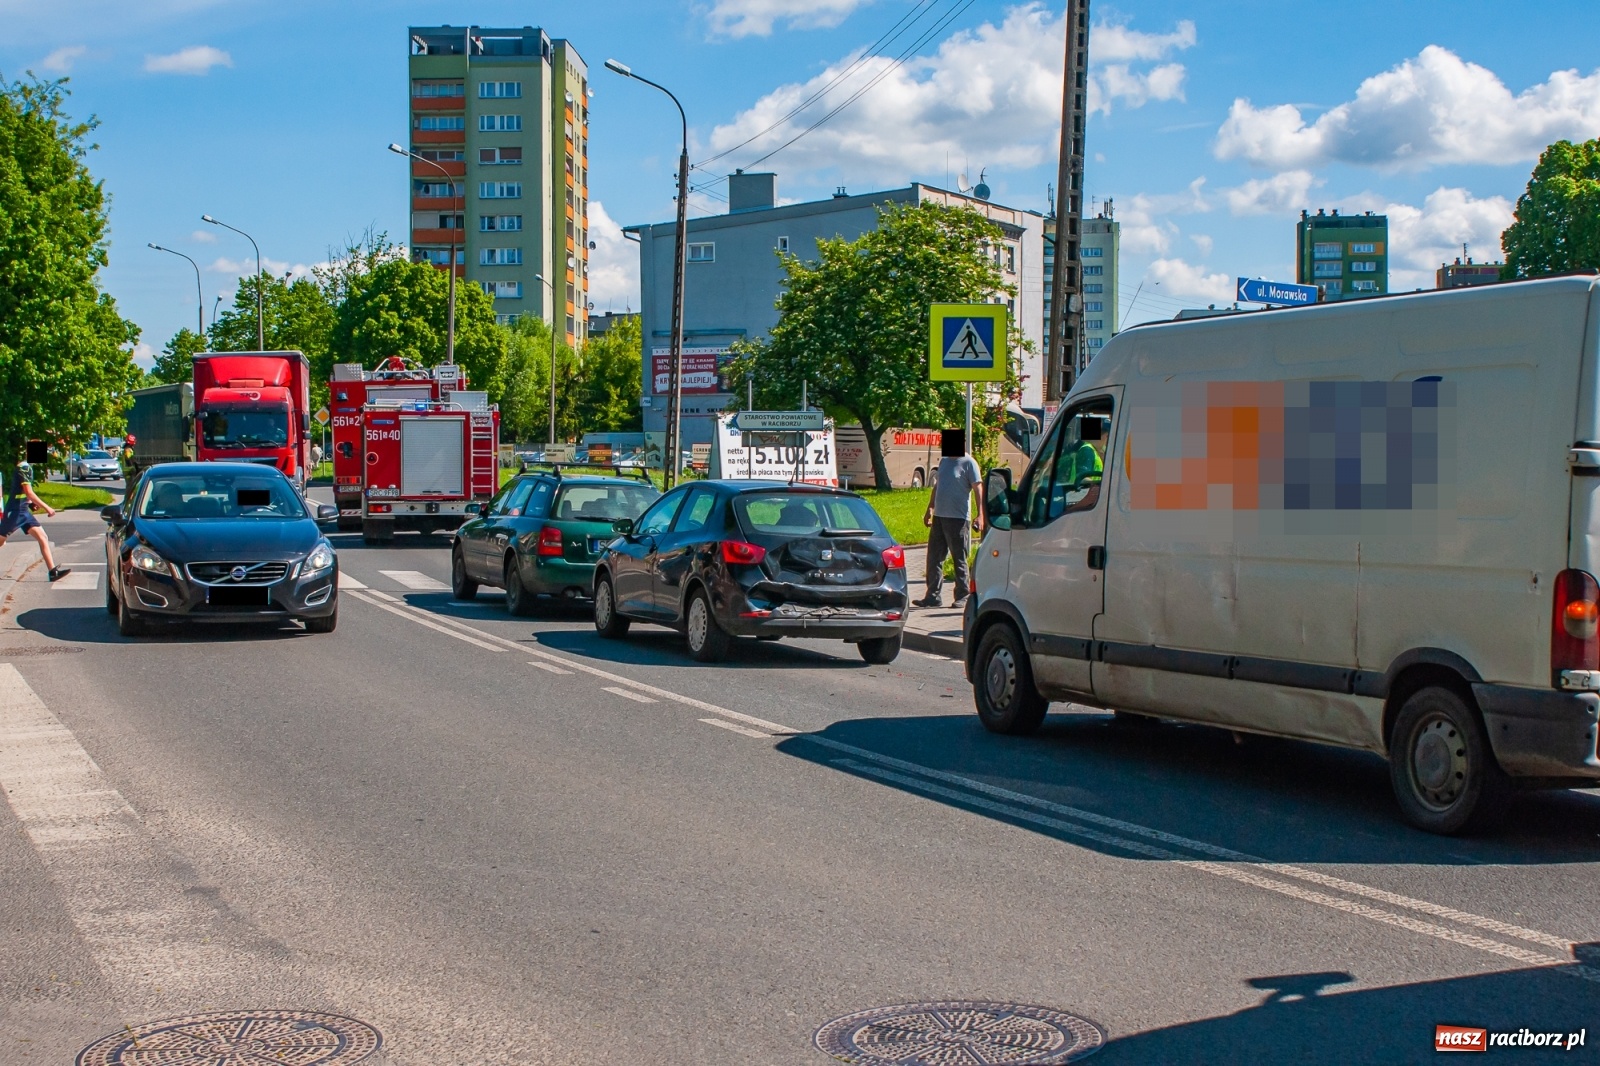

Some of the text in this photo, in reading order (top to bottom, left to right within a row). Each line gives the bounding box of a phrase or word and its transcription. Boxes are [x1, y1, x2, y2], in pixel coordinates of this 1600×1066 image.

[1257, 285, 1307, 302] ul. Morawska
[926, 433, 942, 447] REIS
[814, 444, 829, 465] zł
[758, 469, 774, 477] płaca
[782, 470, 792, 478] tym
